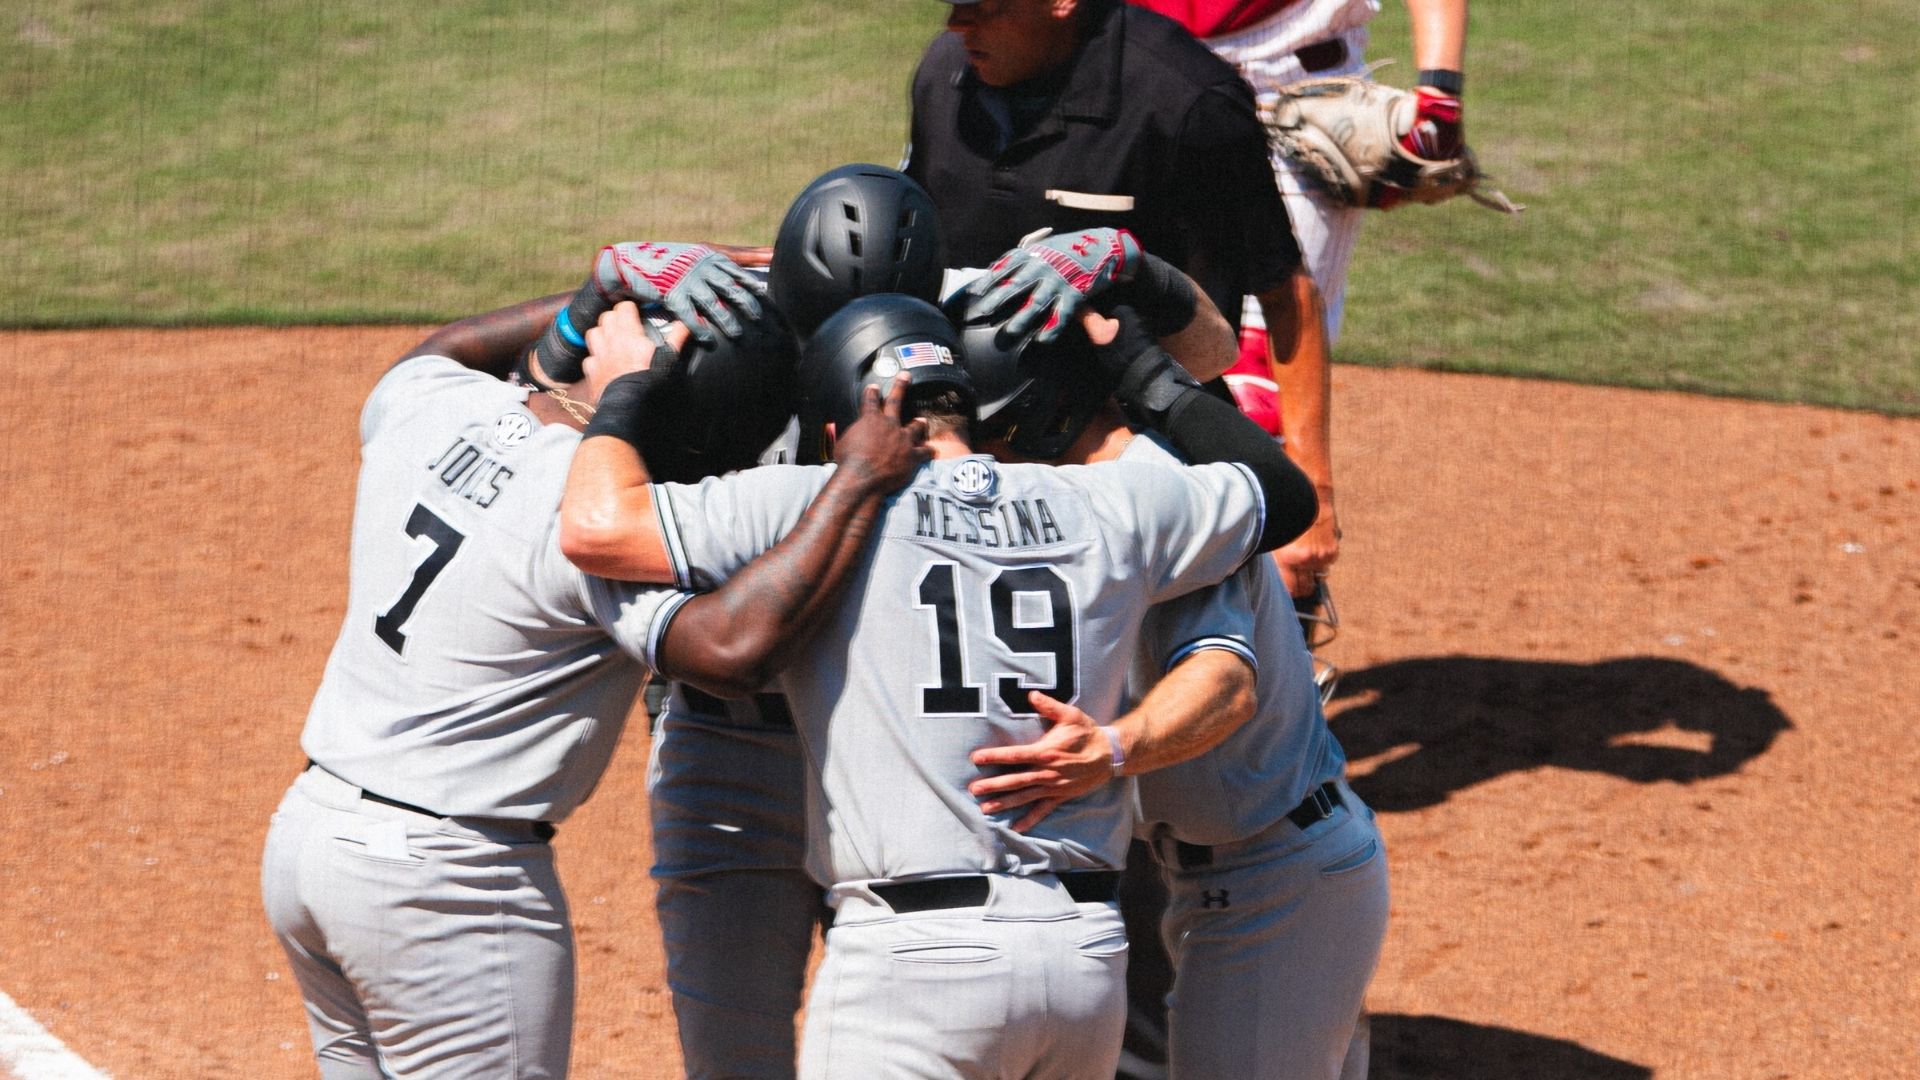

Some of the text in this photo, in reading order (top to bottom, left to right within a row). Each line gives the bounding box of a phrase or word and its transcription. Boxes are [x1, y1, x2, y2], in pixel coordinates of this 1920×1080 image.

[934, 344, 954, 365] 19
[428, 437, 514, 509] JOS
[913, 491, 1066, 548] MESSINA
[372, 500, 468, 660] 7
[911, 560, 1081, 718] 19
